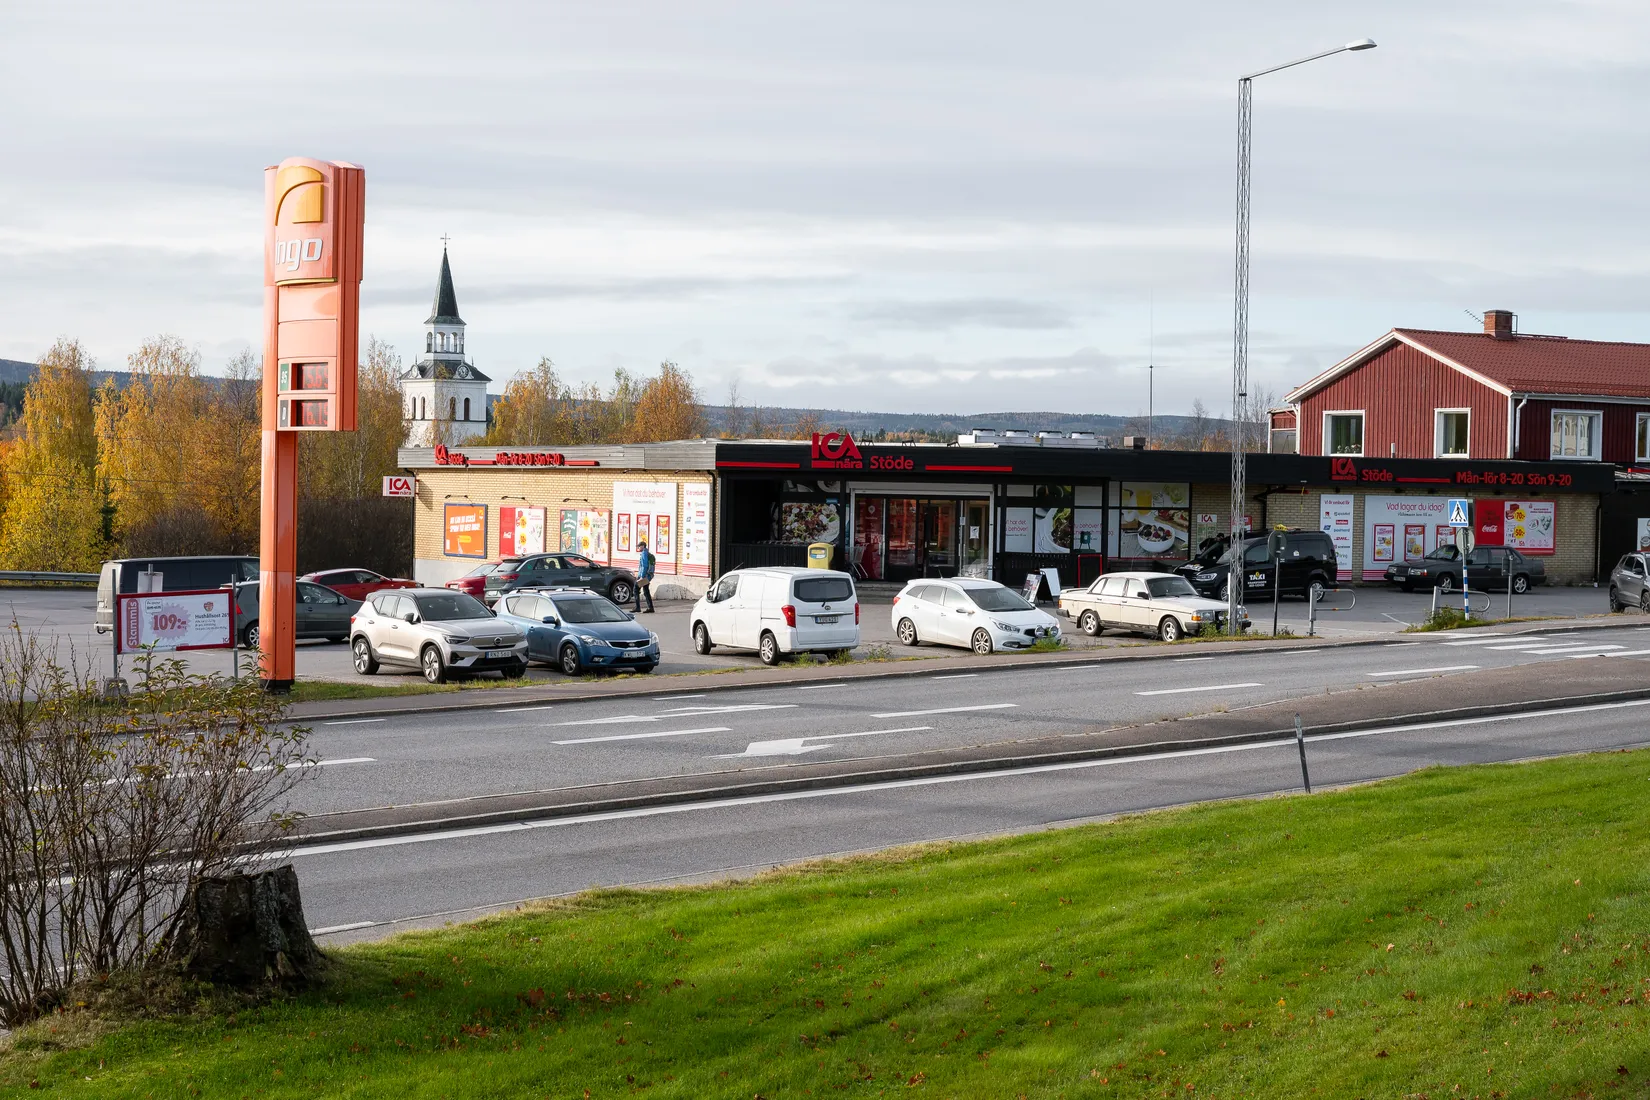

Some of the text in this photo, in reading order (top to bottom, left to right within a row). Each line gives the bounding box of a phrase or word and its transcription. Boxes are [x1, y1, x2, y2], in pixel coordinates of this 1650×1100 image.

[812, 432, 862, 459] ICA
[836, 456, 914, 470] nära Stöde
[1332, 458, 1357, 475] ICA
[1362, 469, 1393, 481] Stöde
[1456, 471, 1572, 486] Mån-lör 8-20 Sön 9-20
[389, 478, 411, 490] ICA
[1400, 503, 1416, 512] lagar
[1428, 503, 1445, 513] idag?
[129, 601, 138, 646] Stammis
[153, 613, 187, 631] 109:-
